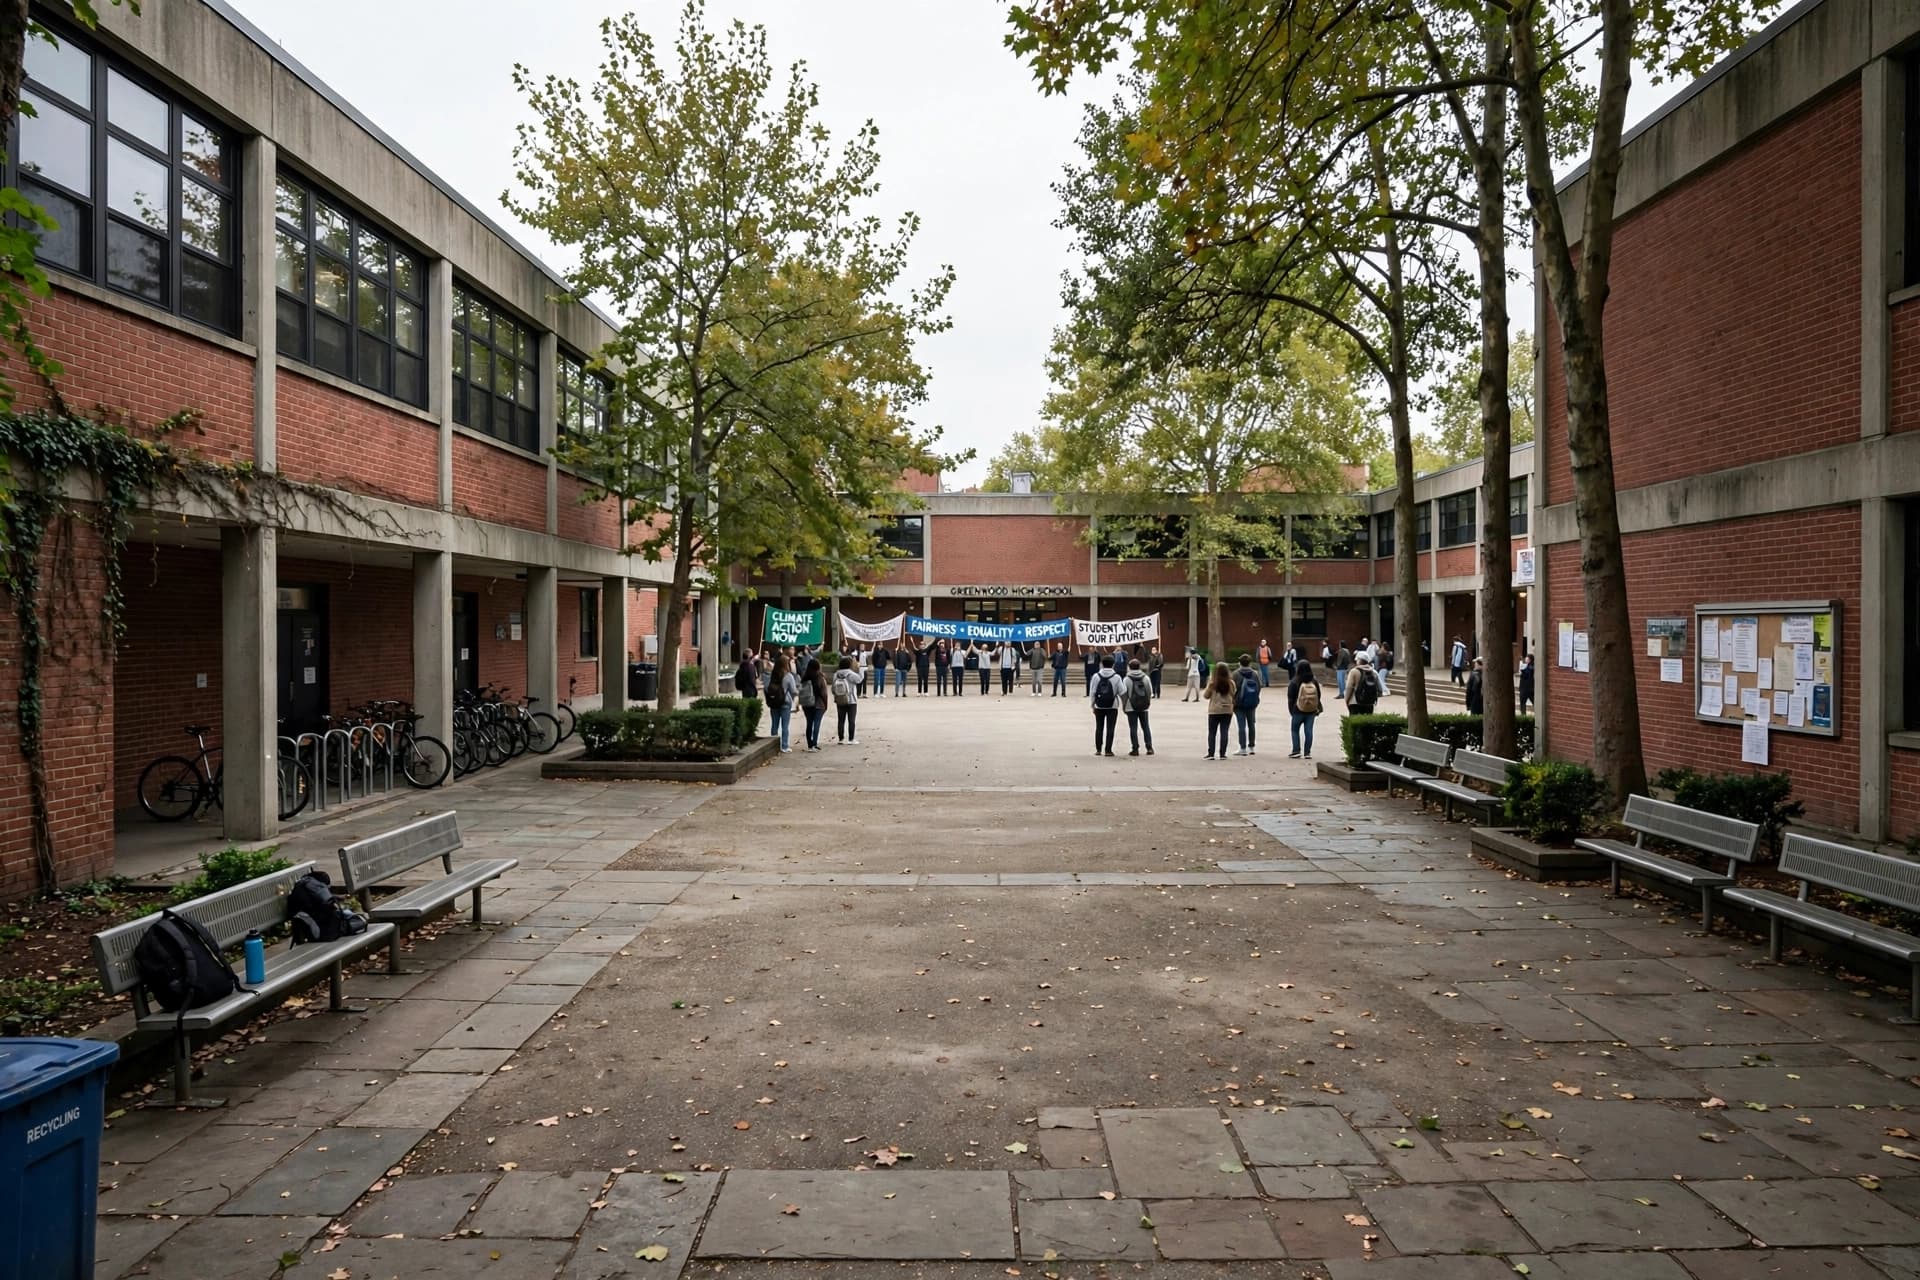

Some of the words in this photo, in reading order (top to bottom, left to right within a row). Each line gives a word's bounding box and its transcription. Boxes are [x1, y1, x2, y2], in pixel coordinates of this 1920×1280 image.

[772, 611, 814, 623] CLIMATE
[772, 622, 810, 633] ACTION
[911, 620, 957, 635] FAIRNESS
[968, 627, 1014, 638] EQUALITY
[1025, 623, 1067, 637] RESPECT
[1079, 623, 1118, 633] STUDENT
[1121, 619, 1152, 631] VOICES
[772, 631, 798, 643] NOW
[1088, 634, 1106, 643] OUR
[1109, 631, 1144, 643] FUTURE
[27, 1107, 80, 1144] RECYCLING
